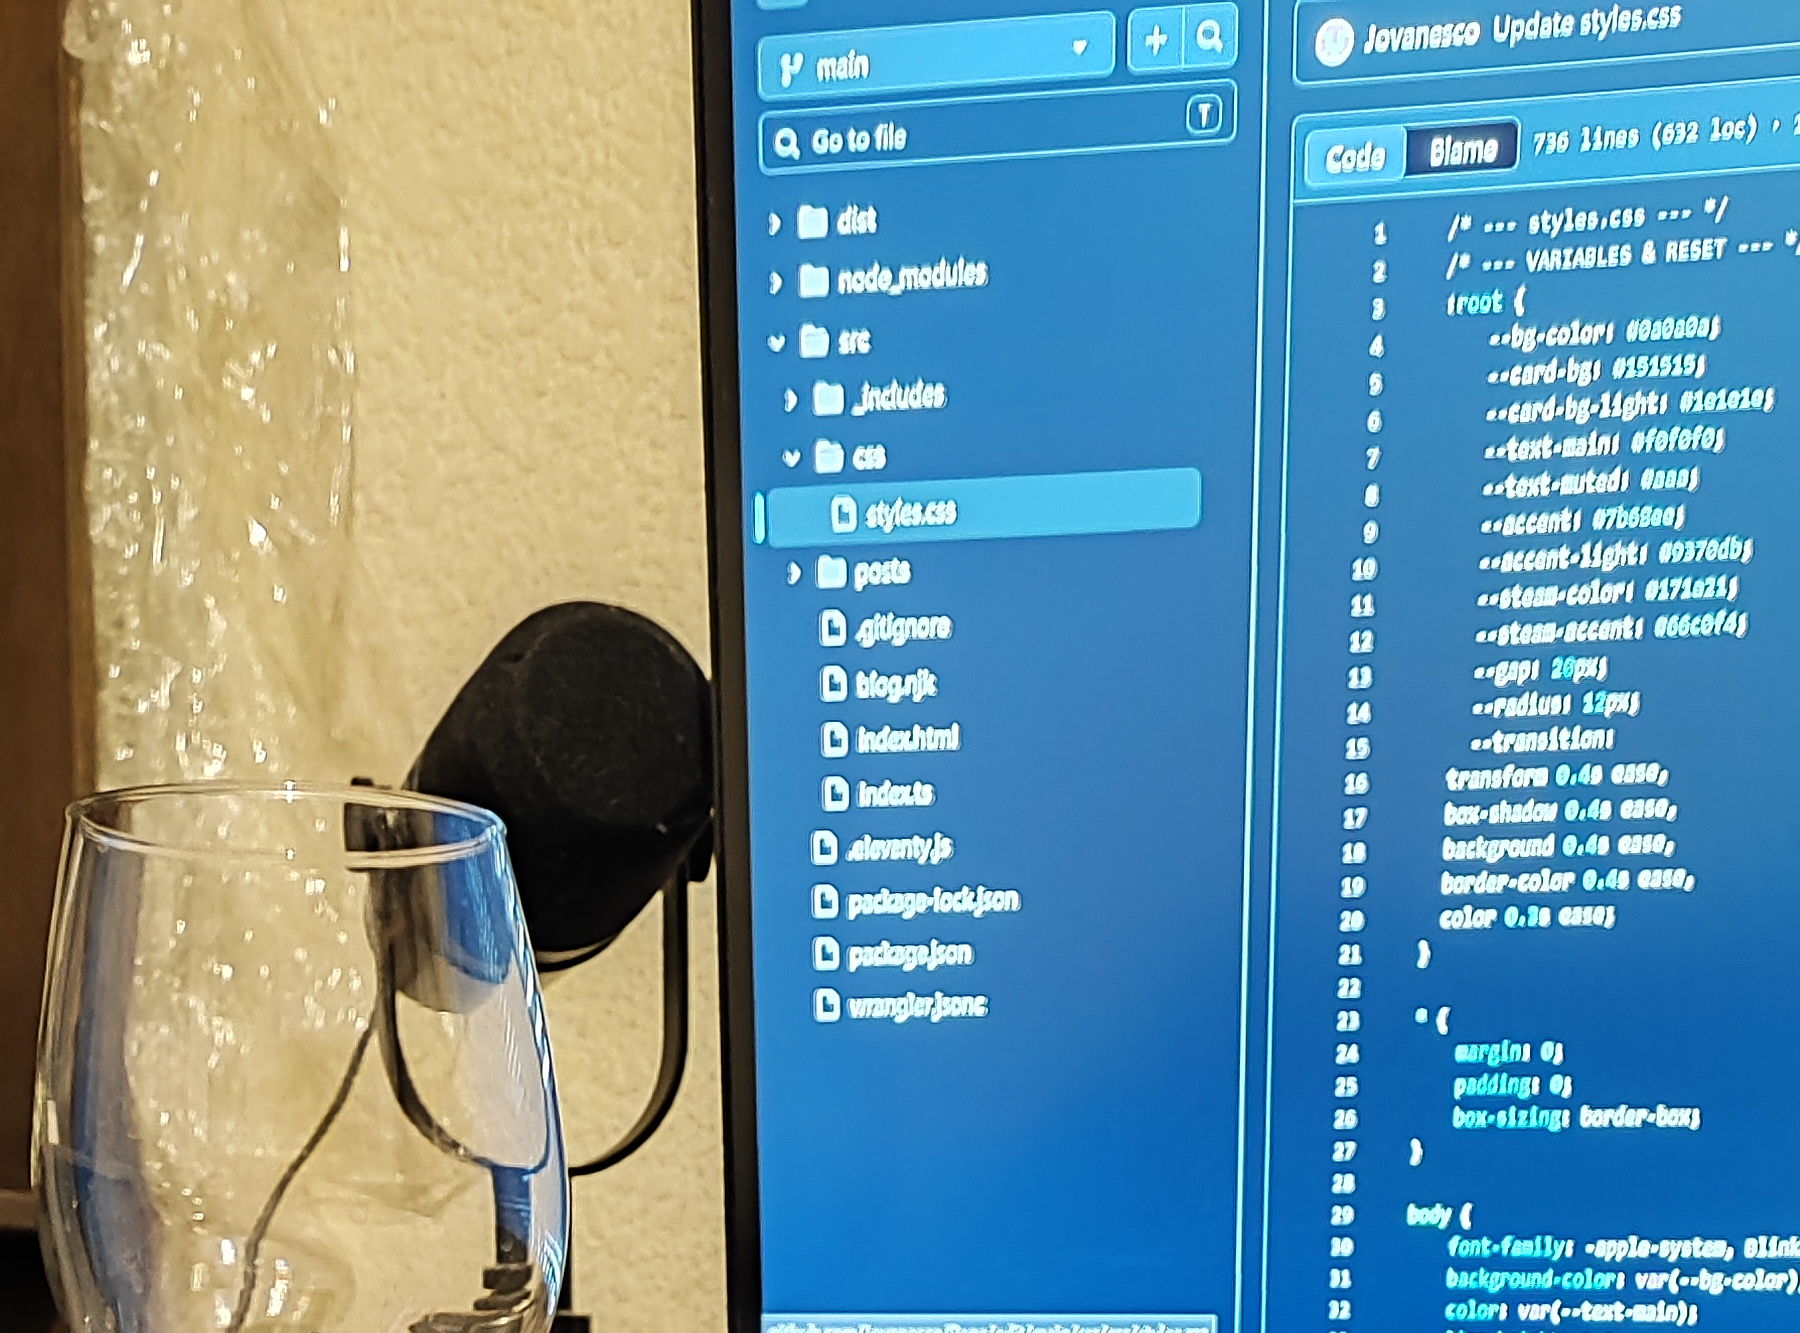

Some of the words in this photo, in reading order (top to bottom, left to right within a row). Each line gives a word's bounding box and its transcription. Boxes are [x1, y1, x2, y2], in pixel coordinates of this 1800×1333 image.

[1364, 22, 1480, 54] Jovanesco
[1494, 10, 1574, 48] Update
[1580, 4, 1681, 40] styles.css
[817, 50, 868, 81] main
[812, 128, 843, 154] Go
[847, 128, 870, 152] to
[874, 122, 906, 150] file
[1431, 135, 1498, 167] Blame
[1534, 131, 1568, 155] 736
[1581, 126, 1639, 152] lines
[1327, 145, 1385, 173] Code
[837, 205, 876, 235] dist
[1529, 208, 1645, 238] styles.css
[1375, 222, 1386, 245] 1
[1526, 244, 1632, 272] VARIABLES
[1666, 238, 1727, 262] RESET
[838, 257, 988, 295] node_modules
[1373, 260, 1387, 283] 2
[1373, 298, 1385, 320] 3
[839, 329, 870, 354] src
[1370, 335, 1383, 357] 4
[1490, 320, 1614, 352] --bg-color:
[1370, 373, 1382, 395] 5
[1488, 356, 1600, 386] --card-bg:
[1368, 411, 1381, 432] 6
[853, 445, 886, 470] css
[1367, 447, 1379, 469] 7
[1485, 430, 1619, 462] --text-main:
[1365, 484, 1379, 507] 8
[866, 497, 956, 533] styles.css
[1364, 521, 1378, 543] 9
[854, 558, 910, 591] posts
[1352, 558, 1377, 581] 10
[1351, 594, 1374, 617] 11
[1350, 630, 1373, 653] 12
[856, 669, 937, 703] blog.njk
[1349, 666, 1372, 688] 13
[1347, 702, 1371, 724] 14
[858, 723, 959, 753] index.html
[1471, 725, 1614, 753] --transition:
[1446, 764, 1548, 790] transform
[858, 780, 933, 807] index.ts
[1344, 808, 1367, 829] 17
[1444, 798, 1558, 825] box-shadow
[1443, 833, 1555, 863] background
[1441, 868, 1575, 895] border-color
[1440, 905, 1497, 929] color
[1336, 1044, 1359, 1064] 24
[1335, 1077, 1358, 1097] 25
[1331, 1206, 1354, 1225] 29
[1407, 1203, 1452, 1229] body
[1446, 1267, 1625, 1293] background-color:
[1445, 1299, 1508, 1321] color:
